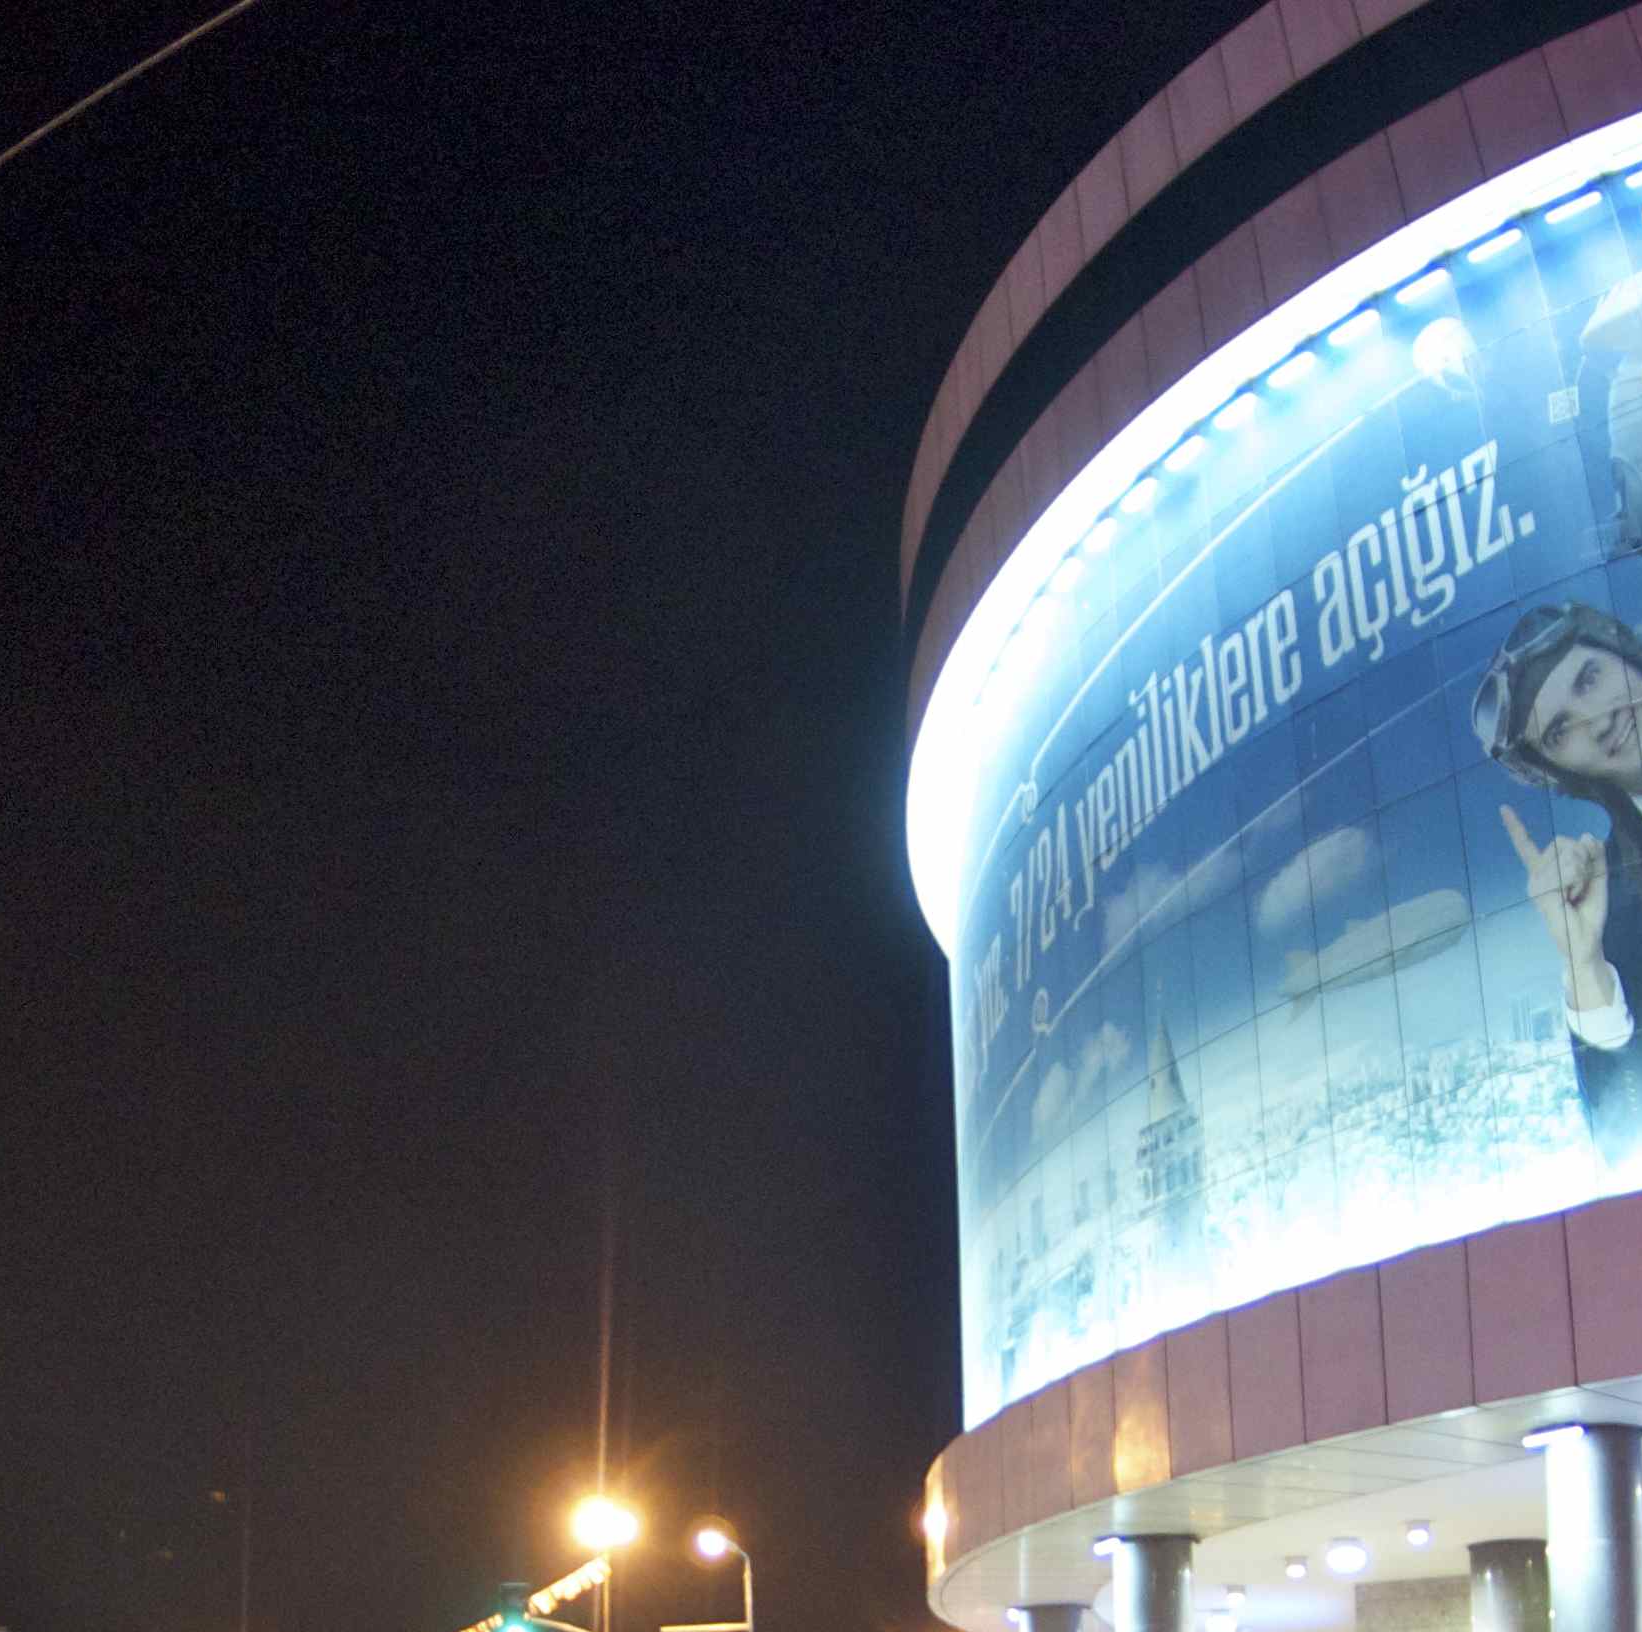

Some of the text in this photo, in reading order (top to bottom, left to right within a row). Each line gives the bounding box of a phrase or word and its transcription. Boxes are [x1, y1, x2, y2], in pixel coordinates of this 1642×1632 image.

[1010, 438, 1535, 992] 7/24 yeniliklere açığız.
